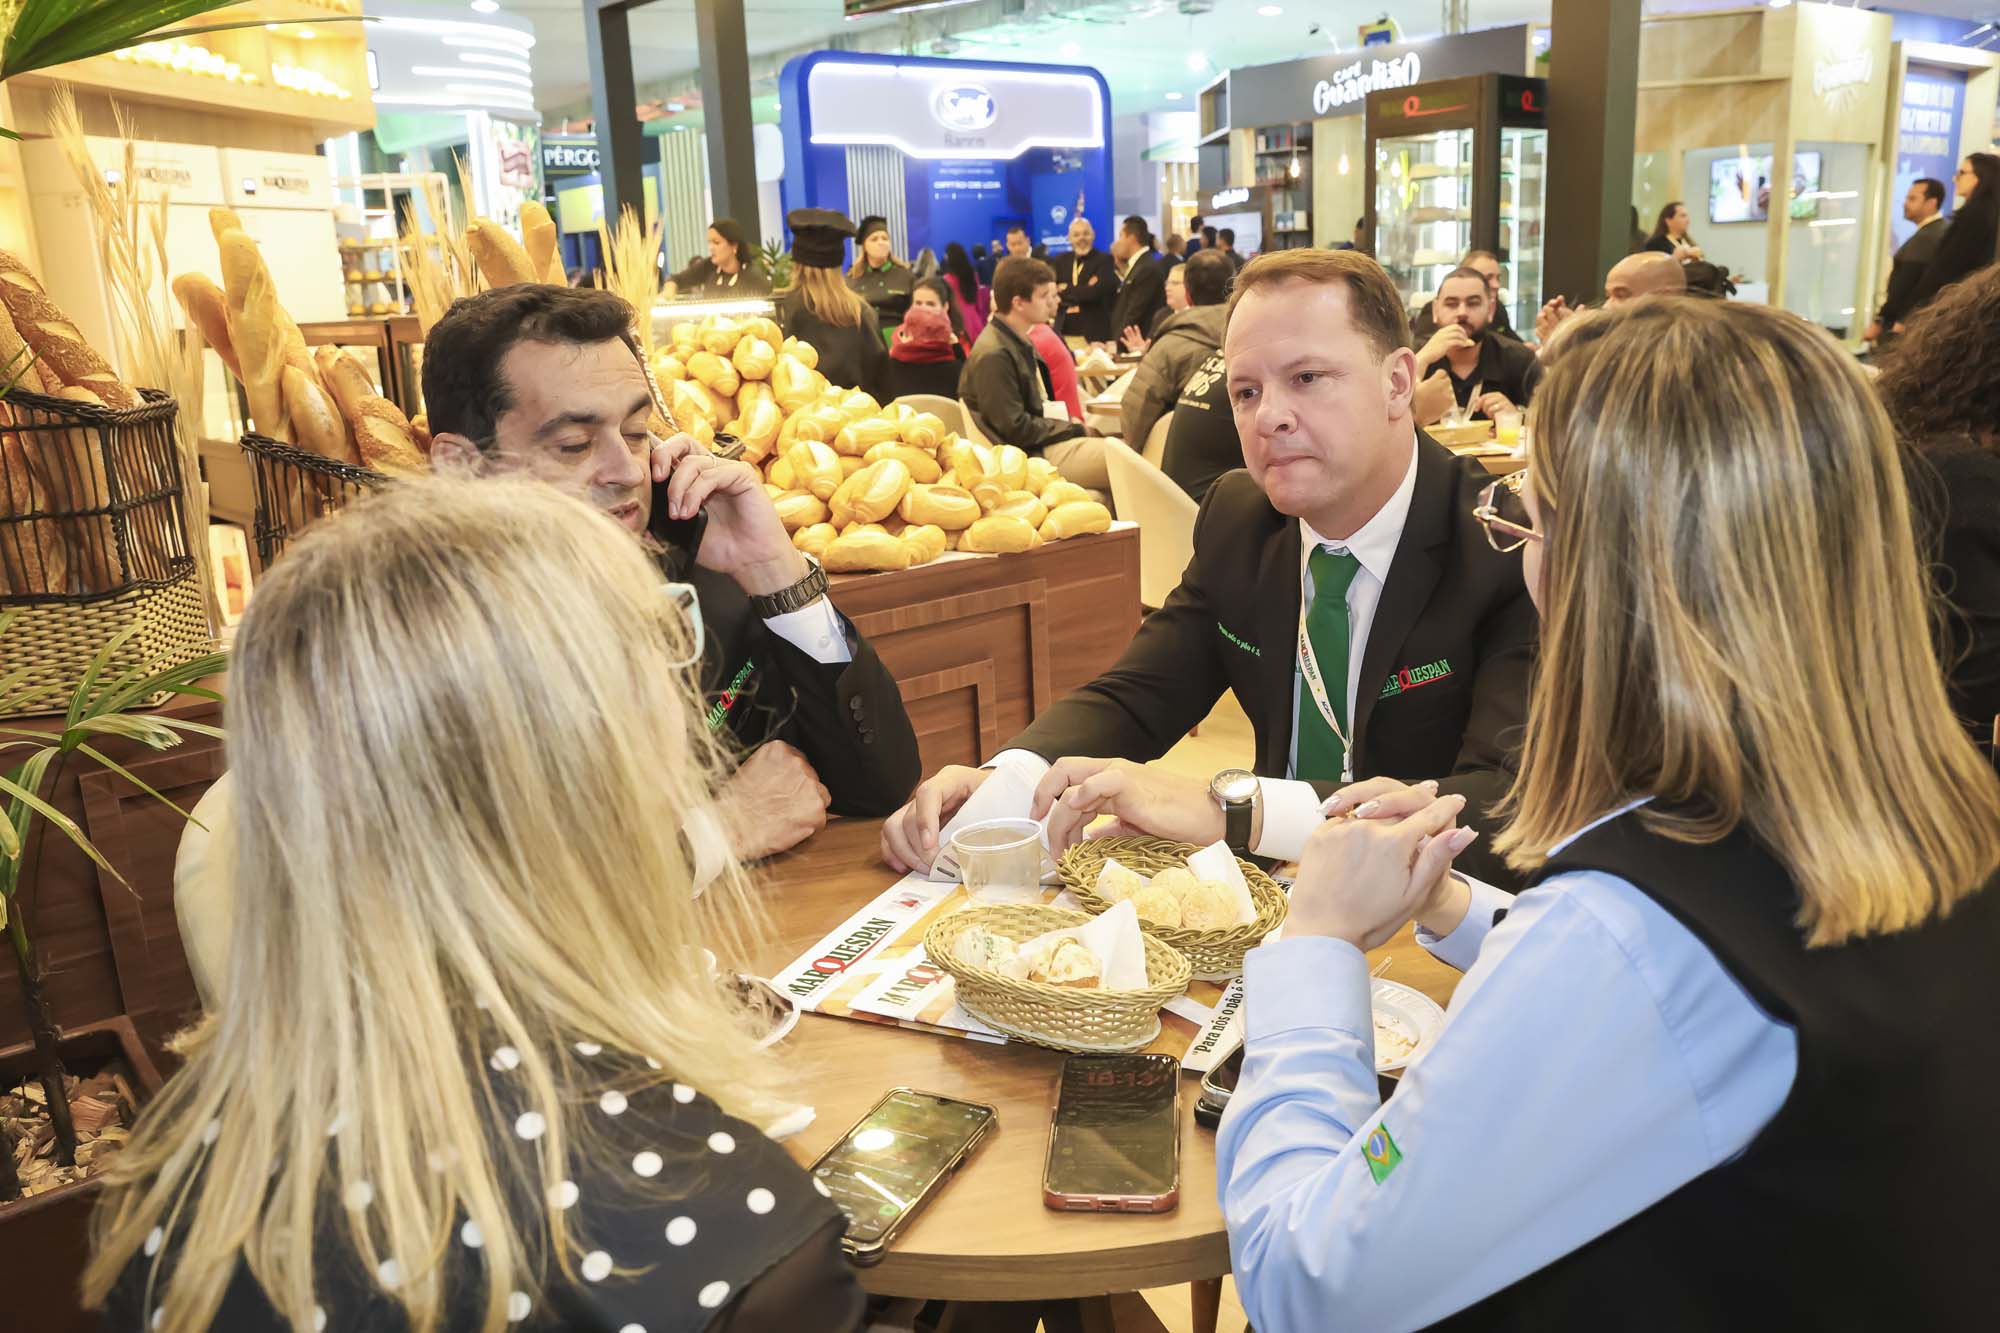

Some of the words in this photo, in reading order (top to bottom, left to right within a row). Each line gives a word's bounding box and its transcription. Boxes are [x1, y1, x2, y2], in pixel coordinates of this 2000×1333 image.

[1381, 658, 1453, 693] ARQUESPAN
[787, 917, 896, 997] MARQUESPAN
[1225, 992, 1244, 1008] pão
[1222, 1008, 1235, 1016] o
[1211, 1016, 1231, 1032] nós
